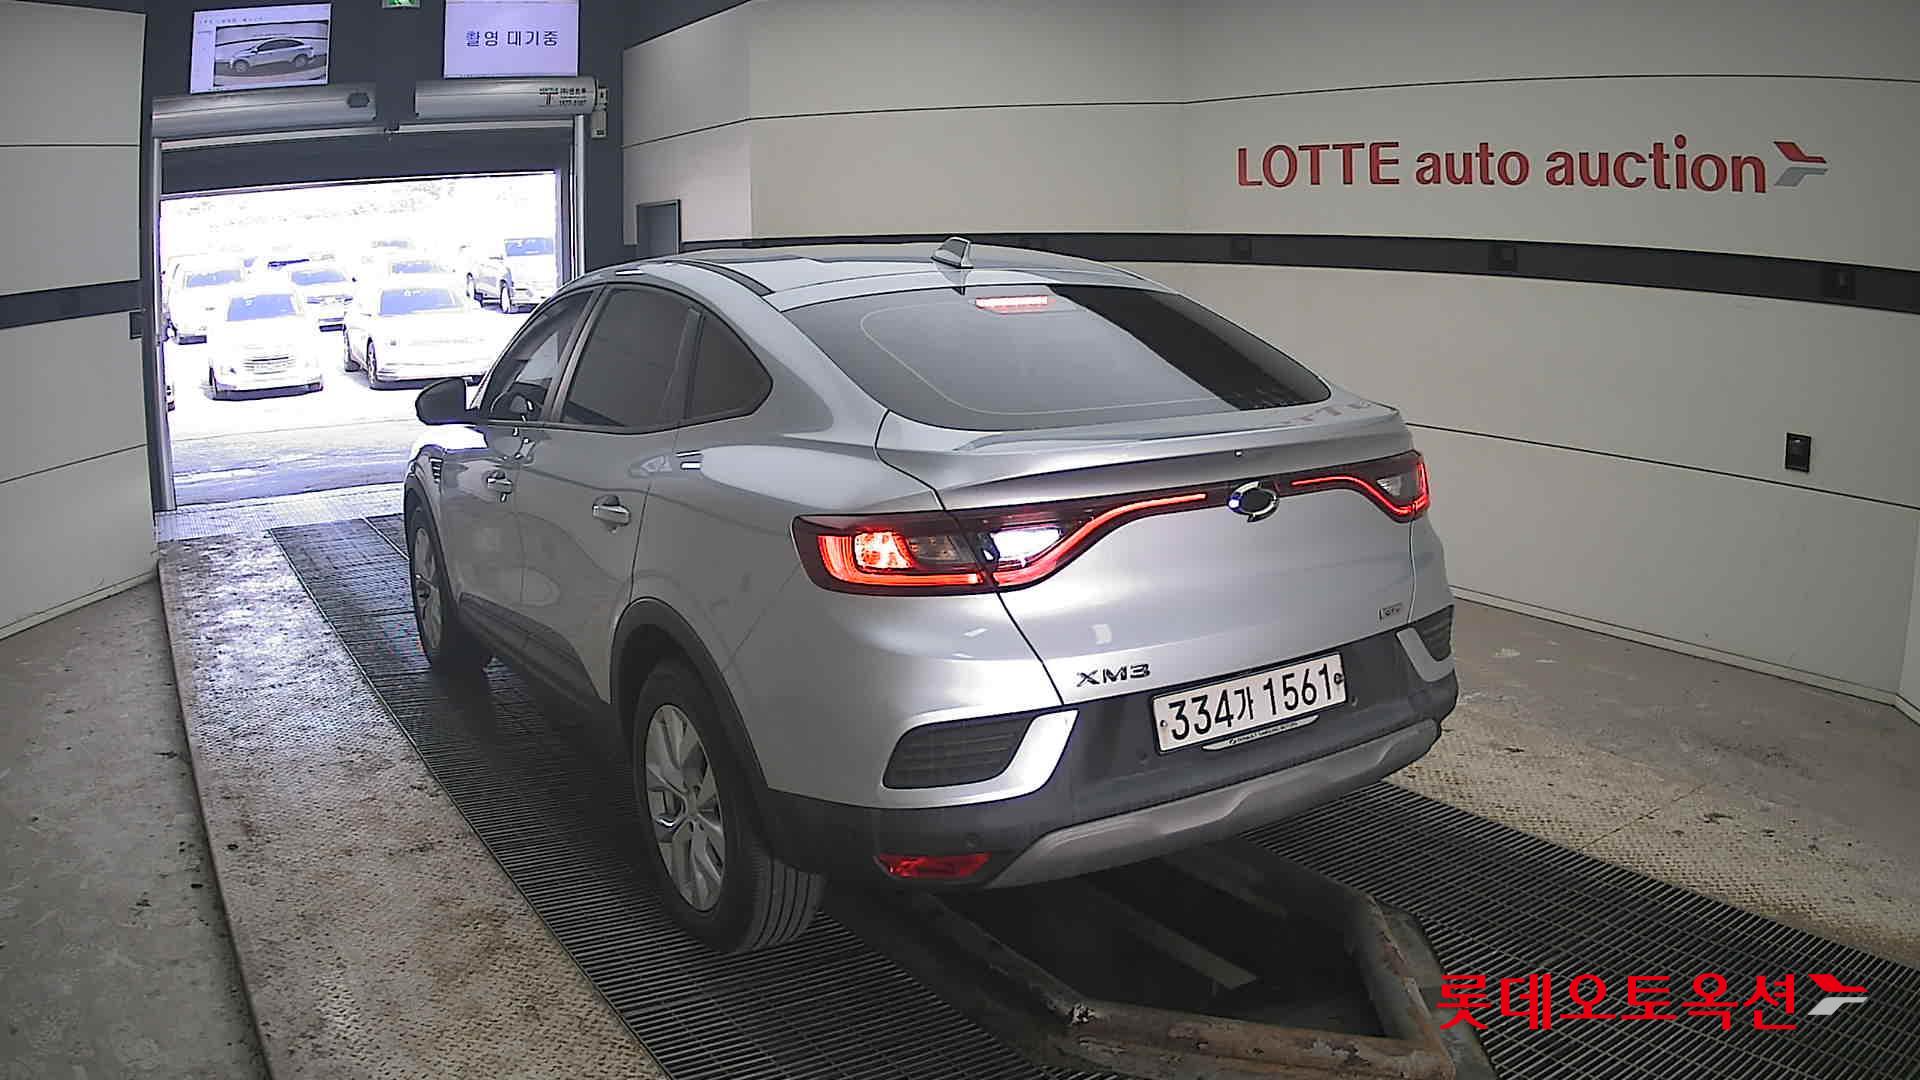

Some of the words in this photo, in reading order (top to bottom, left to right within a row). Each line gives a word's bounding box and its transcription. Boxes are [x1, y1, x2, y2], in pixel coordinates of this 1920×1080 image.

[507, 30, 559, 47] 대기중
[1237, 142, 1399, 188] LOTTE
[1415, 142, 1530, 186] auto
[1545, 134, 1766, 194] auction
[1077, 663, 1151, 688] XM3
[1168, 686, 1254, 740] 334가
[1263, 663, 1332, 716] 1561
